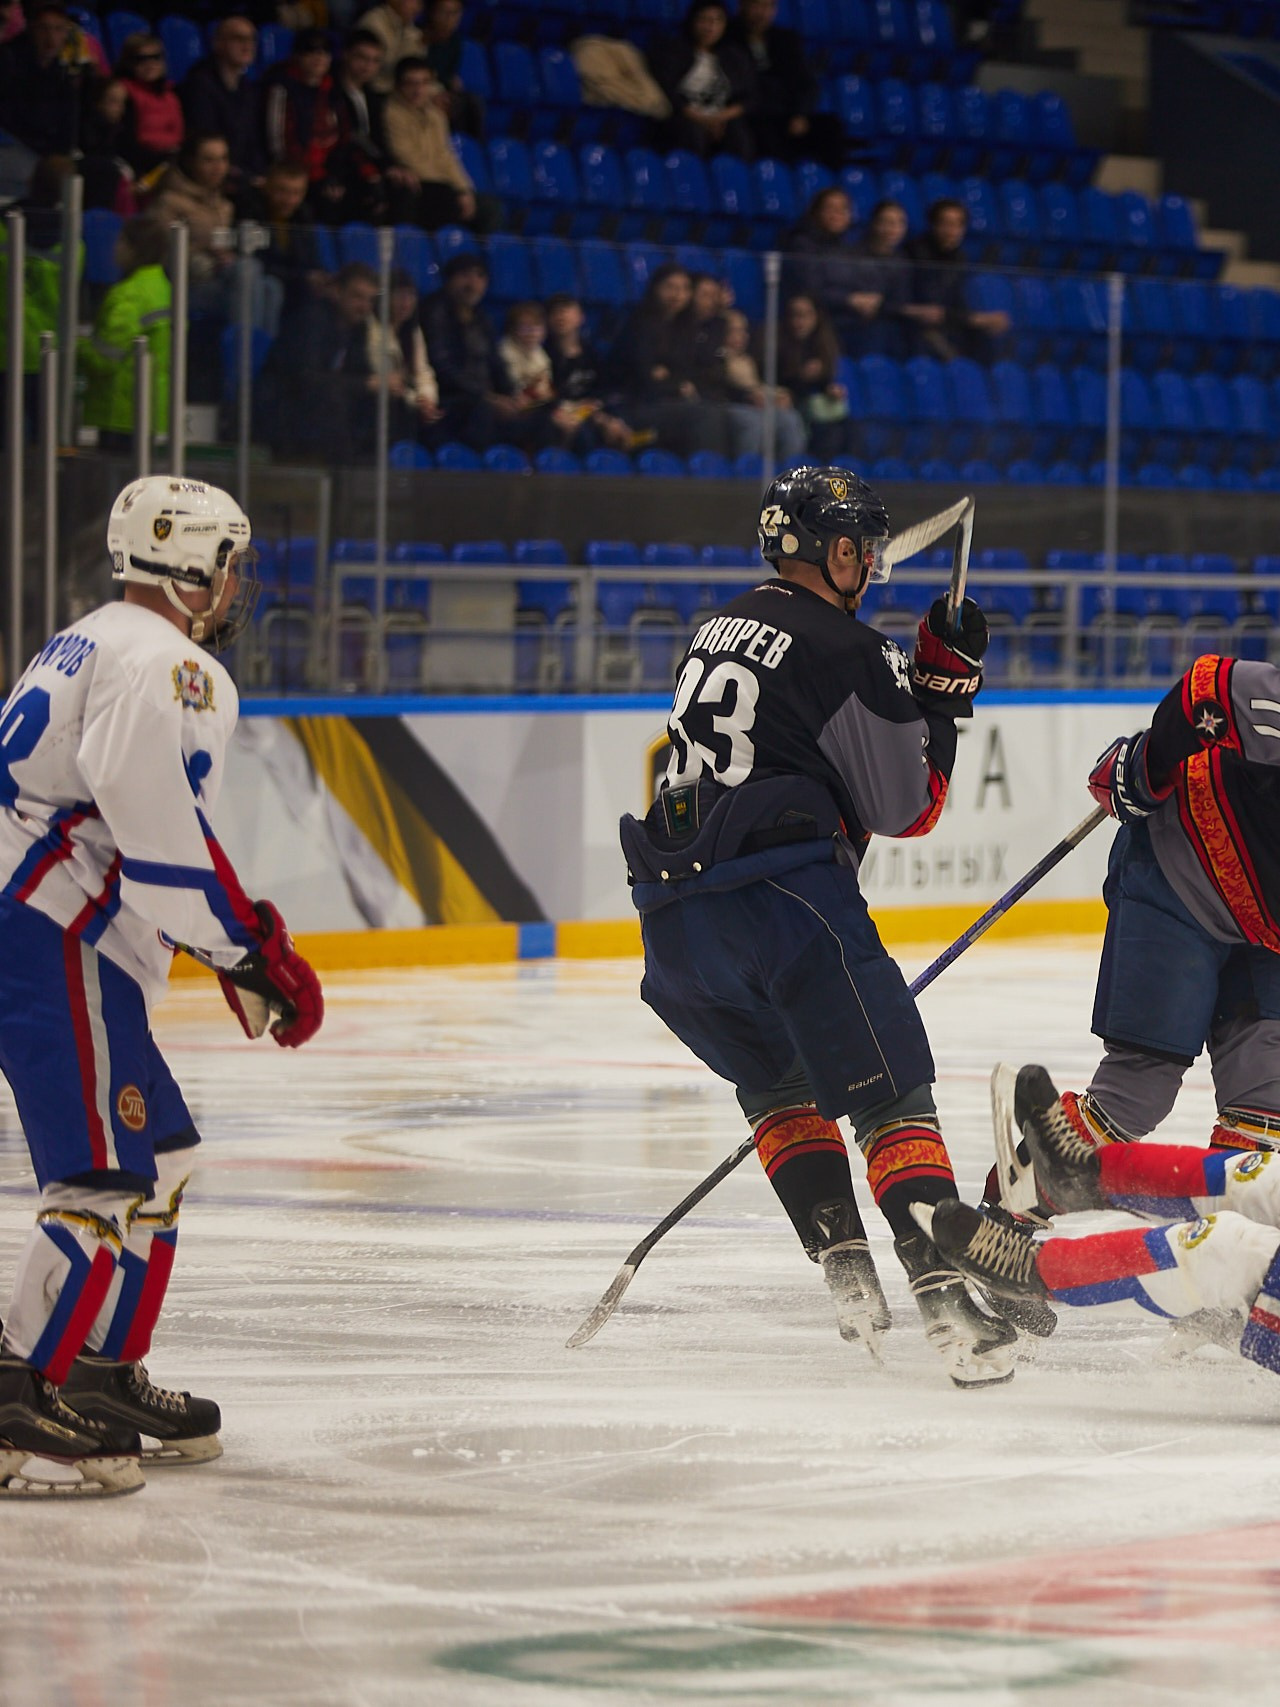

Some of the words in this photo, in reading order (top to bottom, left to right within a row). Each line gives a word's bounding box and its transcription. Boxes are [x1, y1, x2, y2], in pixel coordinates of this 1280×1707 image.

[688, 616, 793, 670] ОКАРЕВ
[913, 668, 981, 695] AUER
[847, 1072, 884, 1092] BAUER
